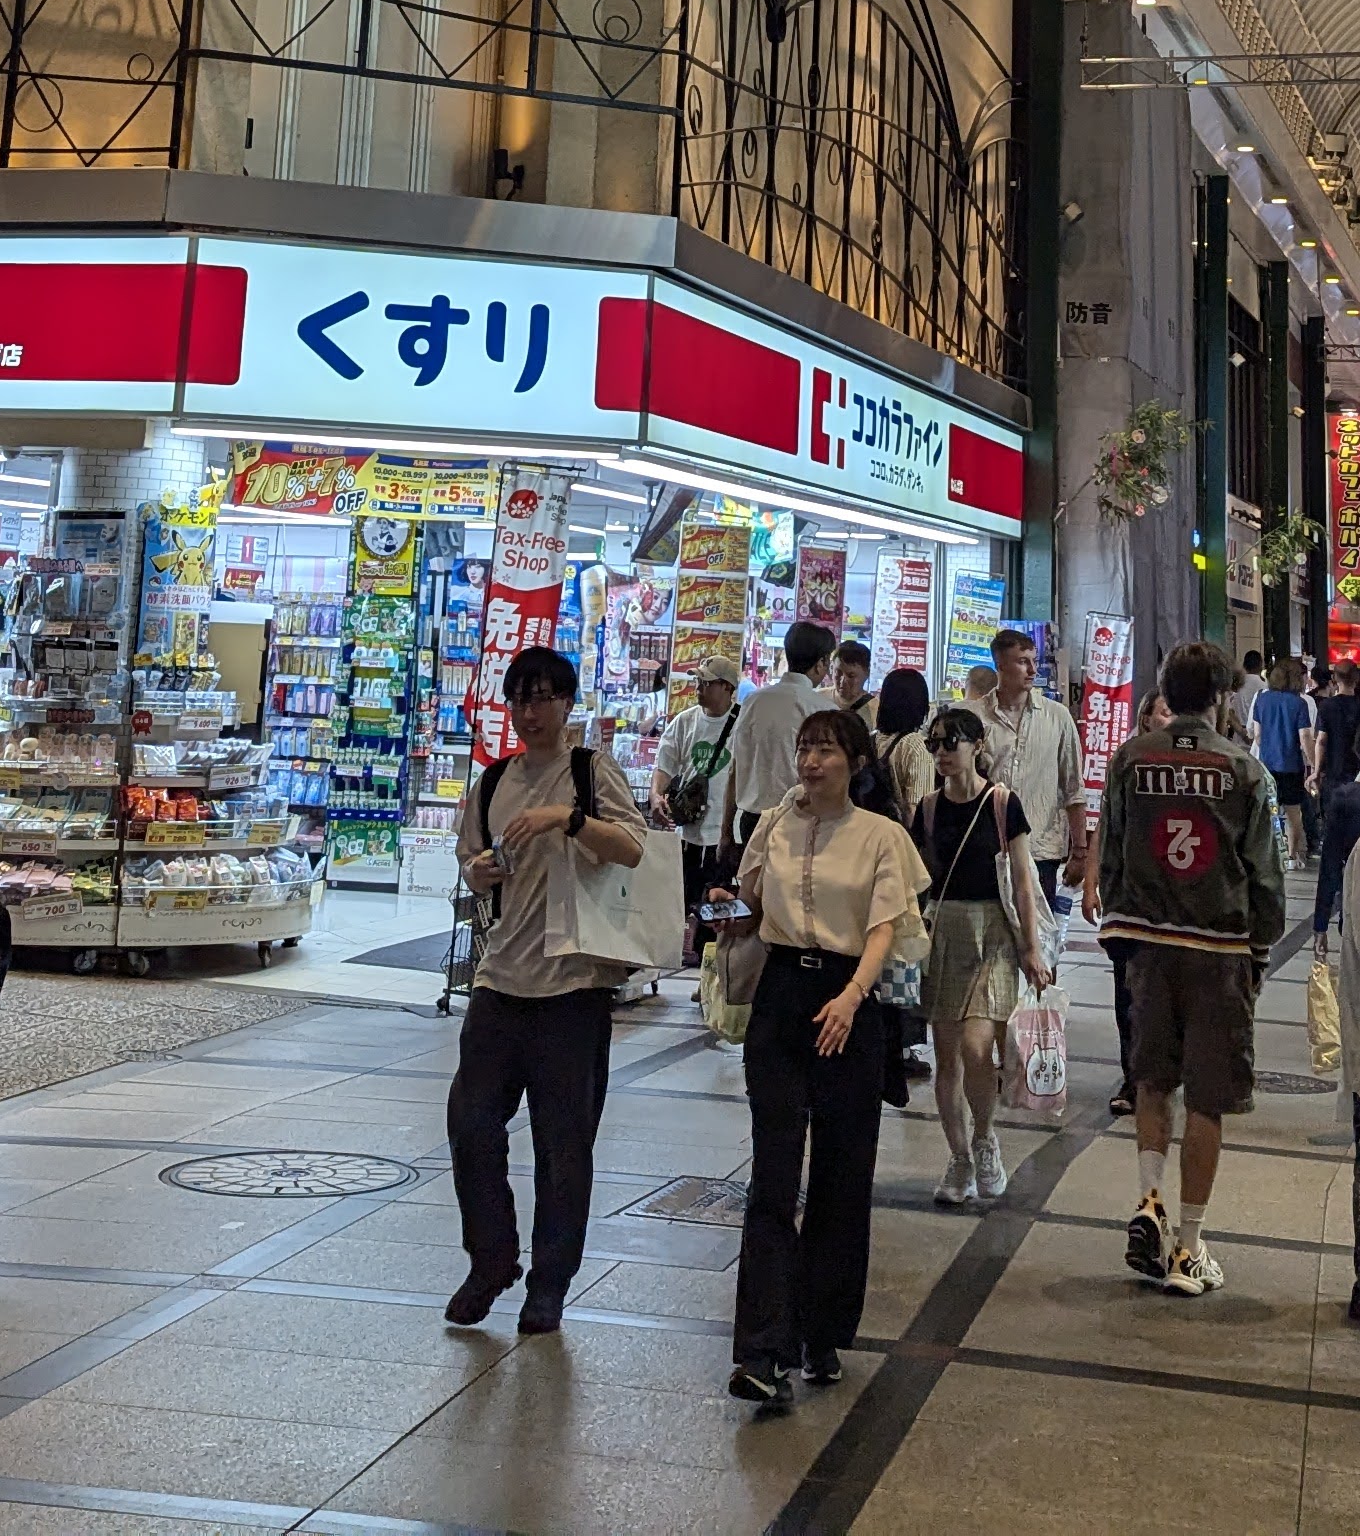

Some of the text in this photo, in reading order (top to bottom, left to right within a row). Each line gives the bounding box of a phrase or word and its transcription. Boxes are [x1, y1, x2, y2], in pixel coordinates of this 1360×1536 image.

[1066, 301, 1112, 324] 防音
[297, 290, 550, 394] くすり
[852, 393, 943, 468] ココカラファイン
[334, 489, 367, 515] OFF
[496, 525, 566, 554] Tax-Free
[502, 549, 549, 573] Shop
[708, 552, 726, 566] OFF
[705, 604, 722, 617] OFF
[1083, 691, 1111, 782] 免税店
